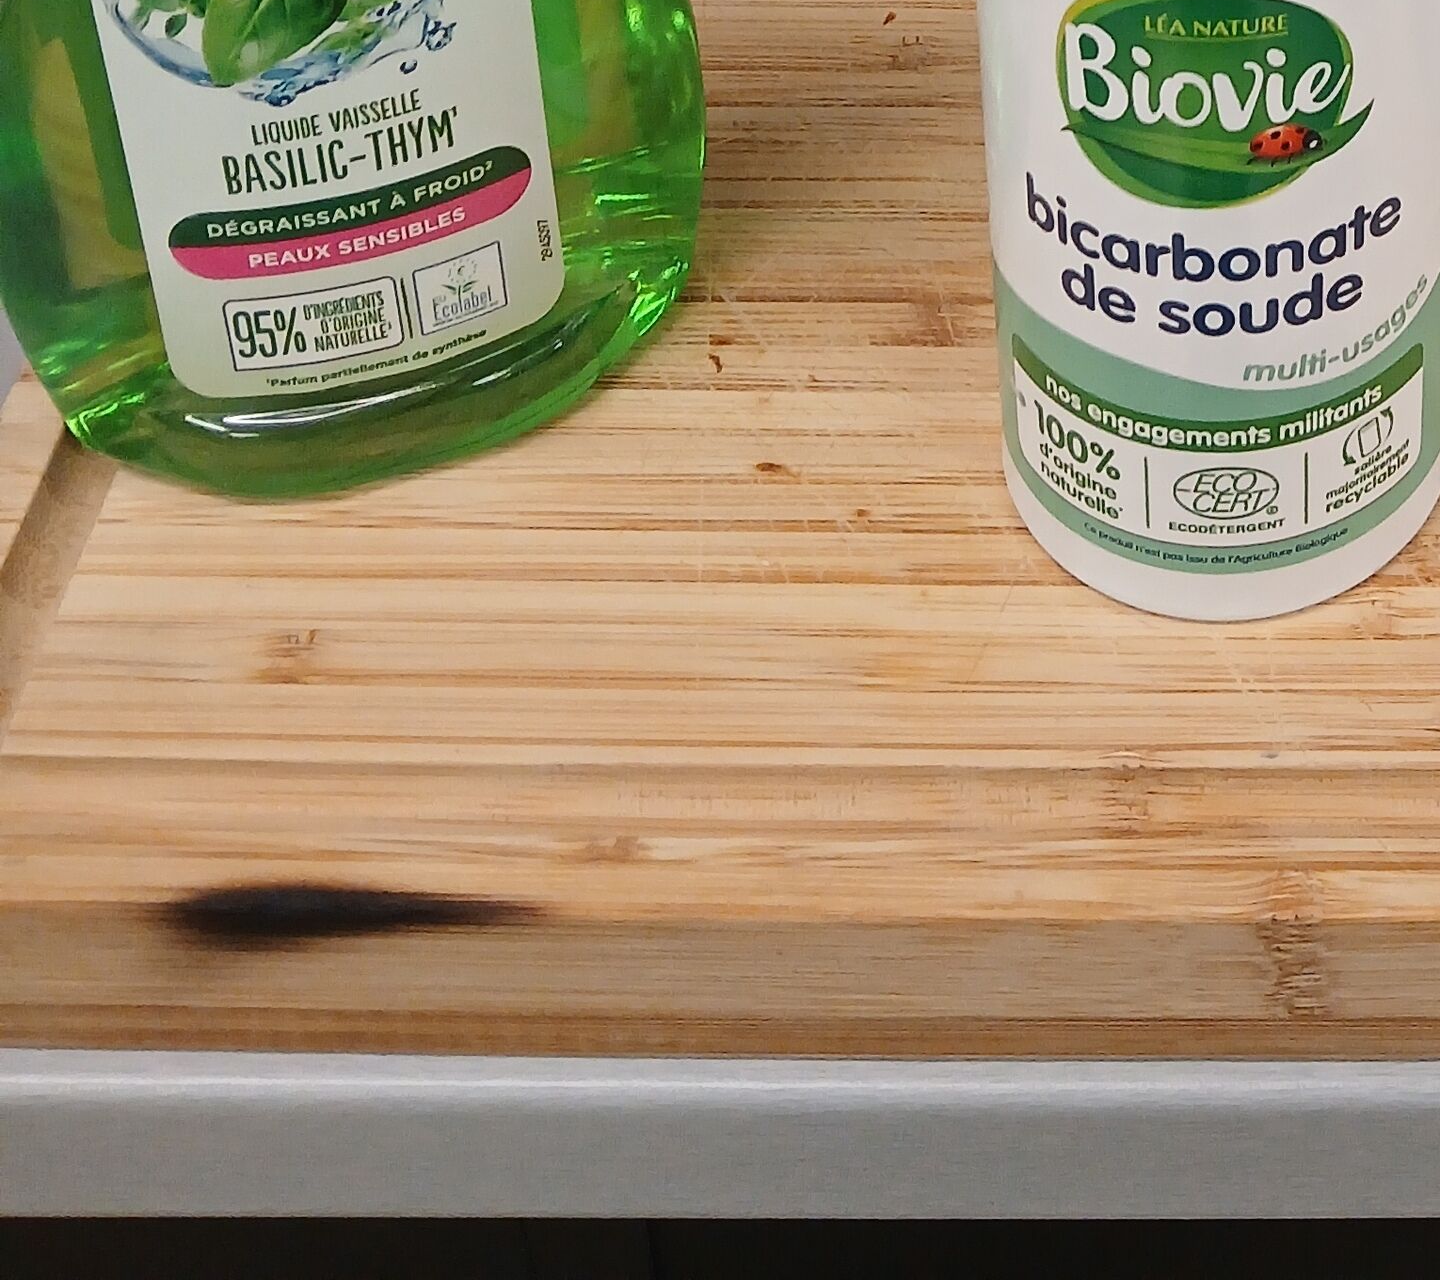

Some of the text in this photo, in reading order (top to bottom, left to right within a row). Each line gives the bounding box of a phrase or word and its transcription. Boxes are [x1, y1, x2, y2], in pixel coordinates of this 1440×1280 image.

[1142, 11, 1289, 37] LÉA NATURE
[1065, 21, 1352, 133] Biovie
[251, 88, 422, 146] LIQUIDE VAISSELLE
[206, 197, 381, 239] DÉGRAISSANT
[390, 190, 407, 211] À
[249, 205, 467, 269] PEAUX SENSIBLES
[1025, 171, 1402, 284] bicarbonate
[303, 290, 385, 322] D'INGRÉDIENTS
[320, 307, 386, 334] D'ORIGINE
[431, 284, 493, 321] Ecolabel
[1060, 261, 1363, 338] de soude
[232, 304, 308, 359] 95%
[412, 348, 430, 362] de
[1243, 271, 1429, 385] multi-usages
[1045, 374, 1382, 448] nos engagements militants
[1033, 399, 1121, 481] 100%
[1354, 444, 1393, 476] salière
[1039, 442, 1117, 501] d'origine
[1193, 471, 1257, 494] ECO
[1325, 452, 1410, 513] recyclable
[1162, 551, 1184, 563] pas
[1210, 555, 1226, 565] de
[1295, 527, 1349, 554] Biologique
[1168, 518, 1286, 534] ECODÉTERGENT
